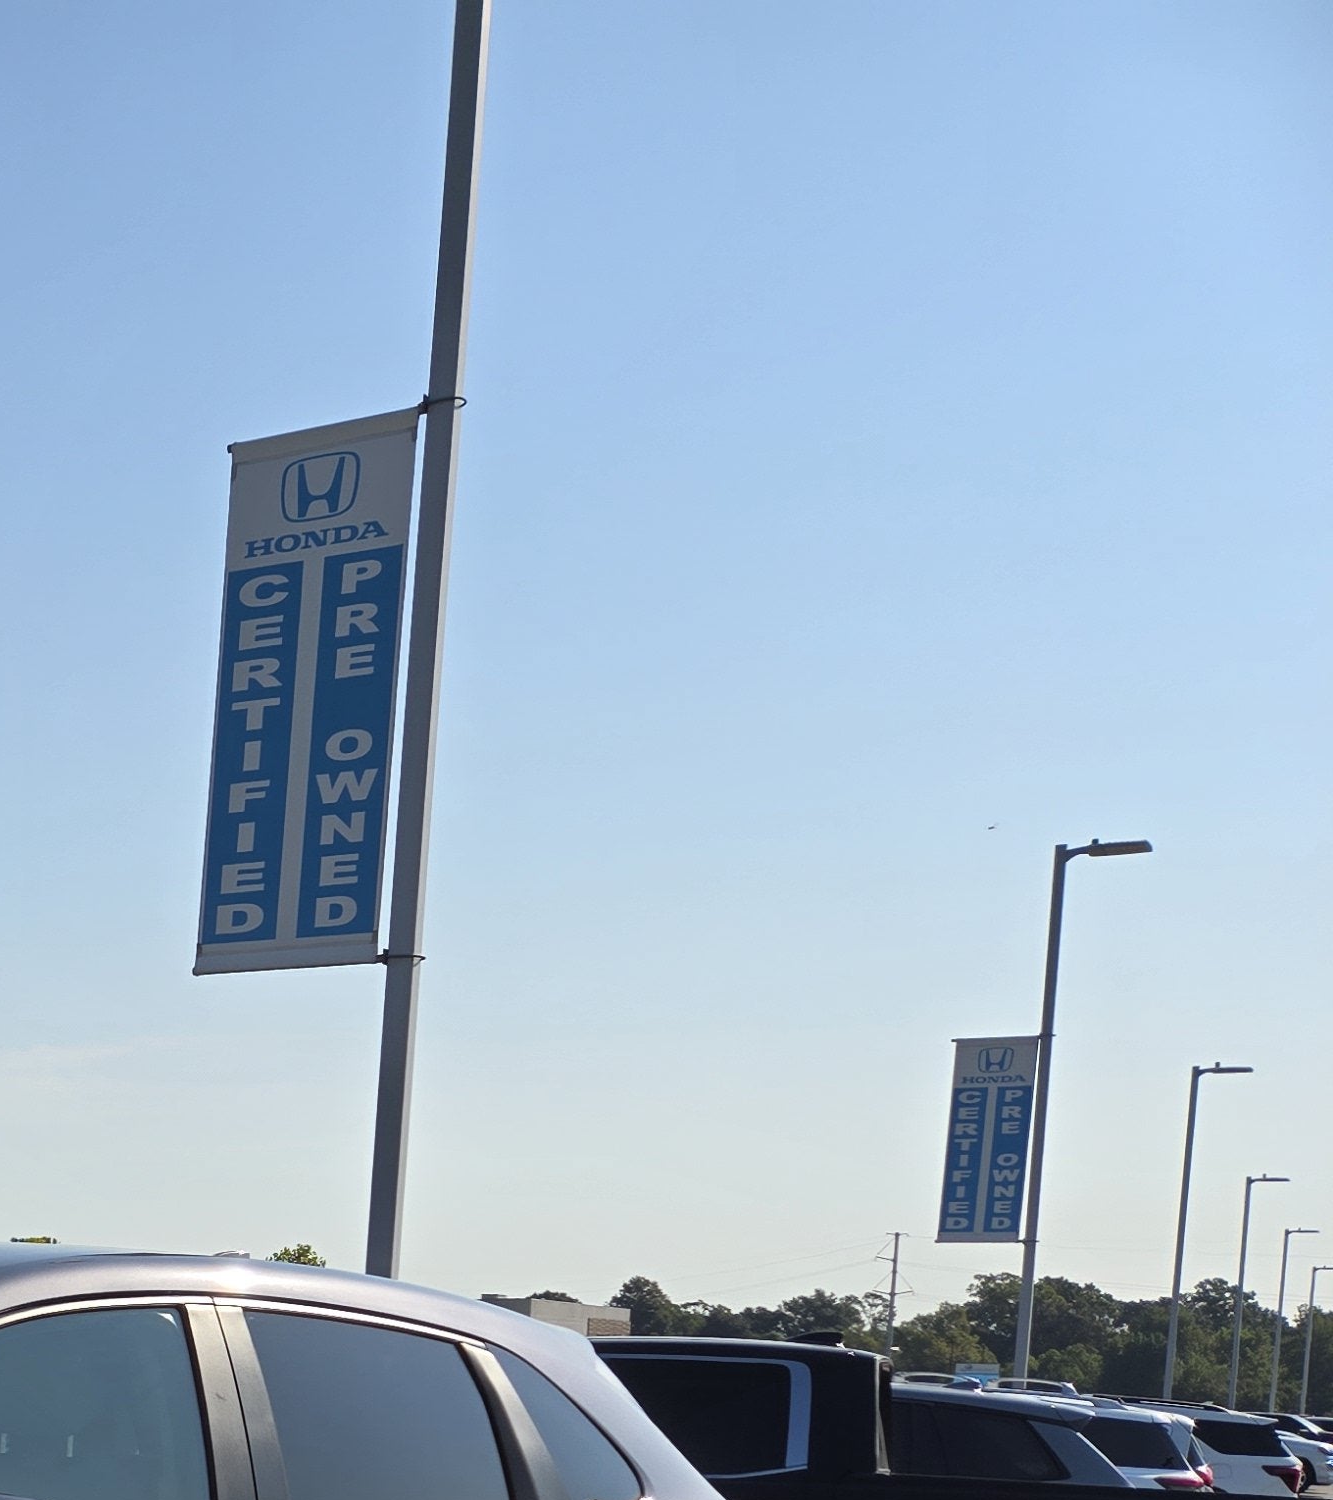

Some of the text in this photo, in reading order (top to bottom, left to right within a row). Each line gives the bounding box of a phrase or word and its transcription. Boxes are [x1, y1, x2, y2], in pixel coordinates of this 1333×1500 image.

[244, 520, 388, 559] HONDA
[215, 574, 291, 936] CERTIFIED
[314, 558, 383, 929] PRE OWNED
[961, 1074, 1027, 1085] HONDA
[945, 1090, 982, 1230] CERTIFIED
[990, 1089, 1024, 1230] PRE OWNED
